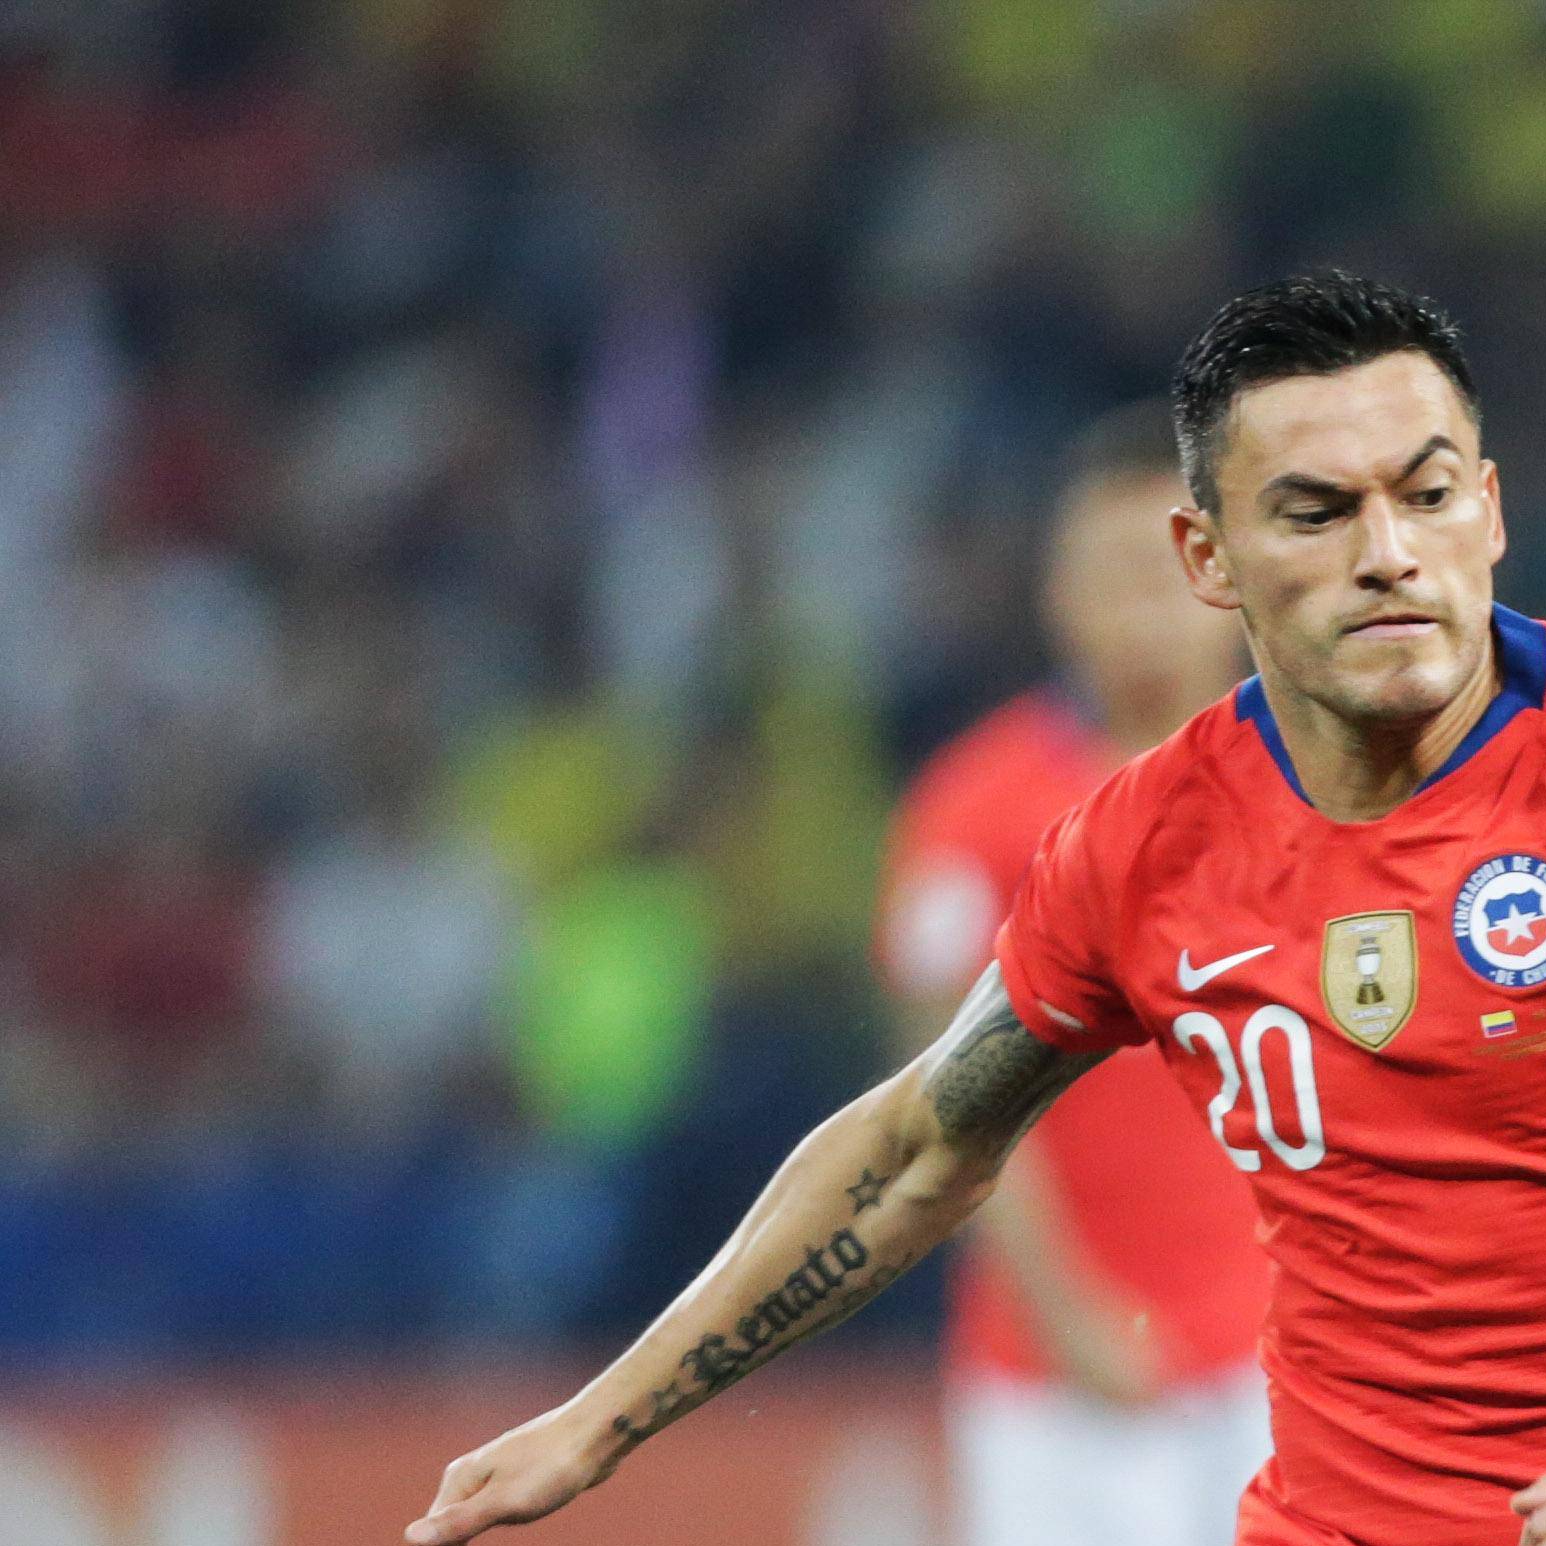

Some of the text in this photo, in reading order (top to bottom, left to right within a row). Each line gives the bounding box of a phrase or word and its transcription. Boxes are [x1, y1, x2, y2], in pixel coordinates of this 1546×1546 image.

[1513, 856, 1532, 872] DE
[1172, 1004, 1326, 1171] 20
[682, 1227, 868, 1390] Renato
